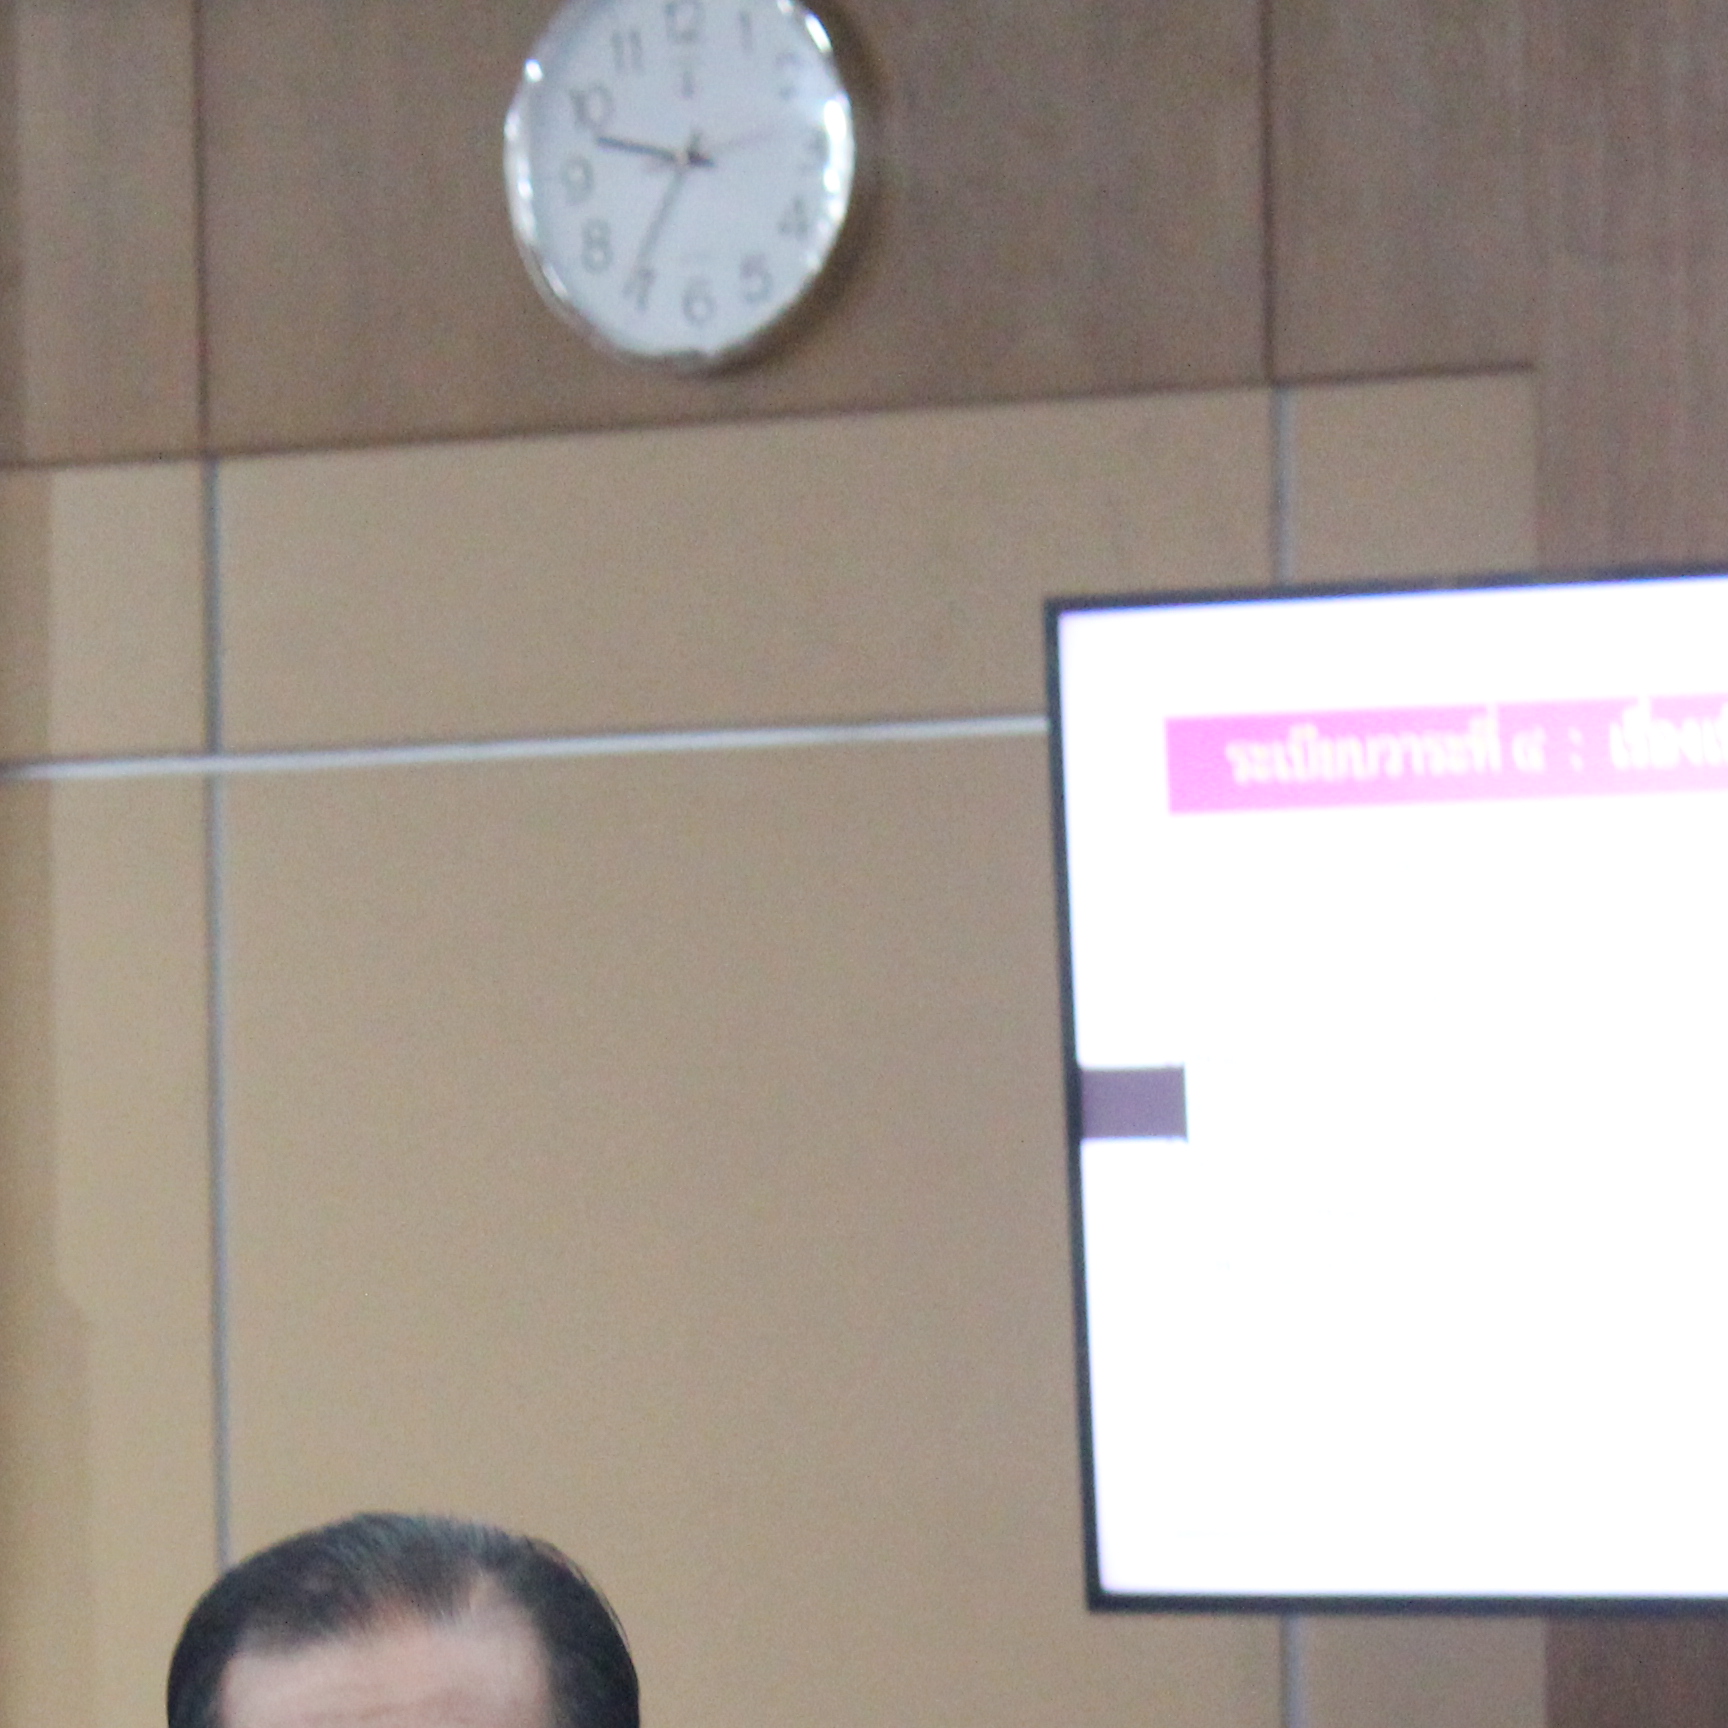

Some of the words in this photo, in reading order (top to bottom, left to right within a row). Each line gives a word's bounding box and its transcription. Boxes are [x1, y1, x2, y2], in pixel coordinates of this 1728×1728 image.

[612, 30, 644, 73] 11
[561, 154, 594, 206] 9
[581, 219, 615, 275] 8
[625, 269, 657, 312] 7
[682, 276, 716, 324] 6
[741, 254, 773, 304] 5
